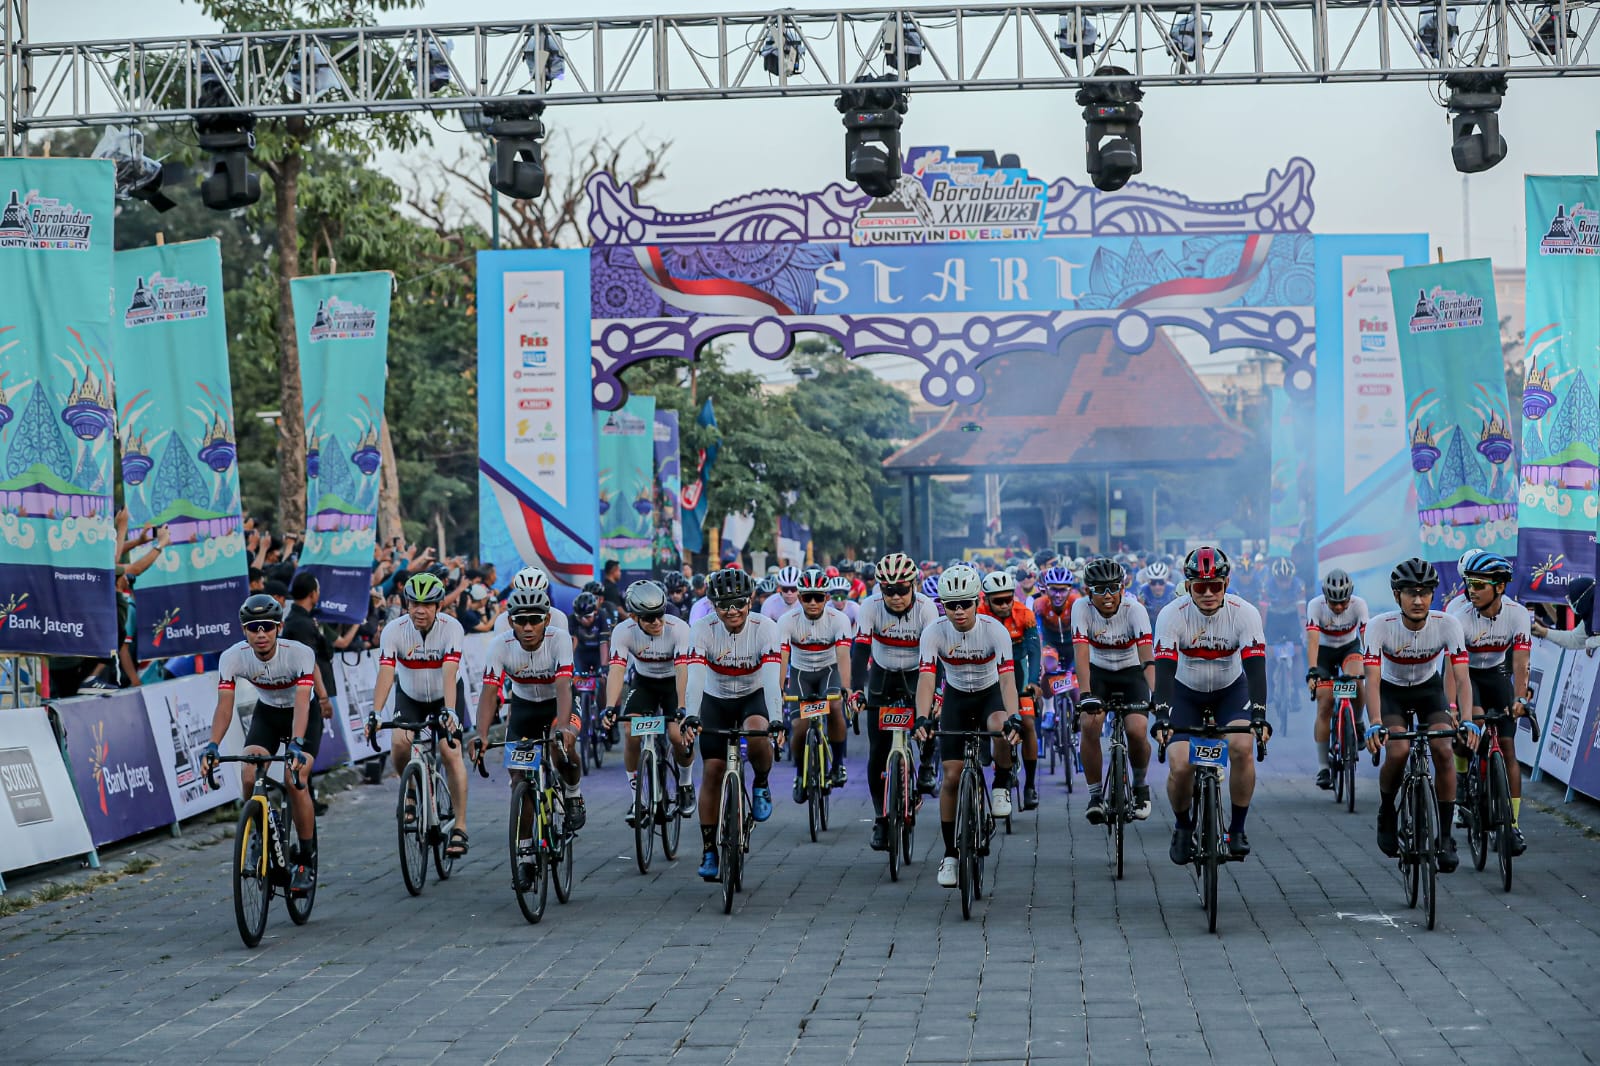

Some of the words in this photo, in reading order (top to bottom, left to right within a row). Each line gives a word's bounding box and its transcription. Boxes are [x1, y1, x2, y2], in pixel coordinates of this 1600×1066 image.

[933, 181, 1042, 202] Borobudur
[33, 209, 91, 224] Borobudur
[940, 203, 984, 224] XXIII
[986, 203, 1033, 223] 2023
[36, 225, 60, 238] XXIII
[61, 225, 87, 238] 2023
[872, 231, 923, 242] UNITY
[928, 230, 945, 241] IN
[949, 228, 1042, 241] DIVERSITY
[1, 239, 28, 248] UNITY
[41, 241, 88, 249] DIVERSITY
[813, 256, 1087, 304] START
[158, 284, 206, 300] Borobudur
[1440, 296, 1482, 311] Borobudur
[54, 572, 85, 581] Powered
[87, 573, 96, 582] by
[1546, 572, 1574, 585] Bank
[9, 614, 41, 630] Bank
[43, 616, 84, 638] Jateng
[166, 625, 194, 639] Bank
[195, 623, 231, 639] Jateng
[1333, 683, 1356, 693] 098
[803, 702, 826, 713] 258
[635, 719, 661, 731] 097
[882, 712, 913, 726] 007
[511, 750, 536, 763] 159
[1195, 745, 1223, 759] 158
[1, 762, 39, 792] SUKUN
[103, 764, 128, 794] Bank
[124, 762, 154, 798] Jateng
